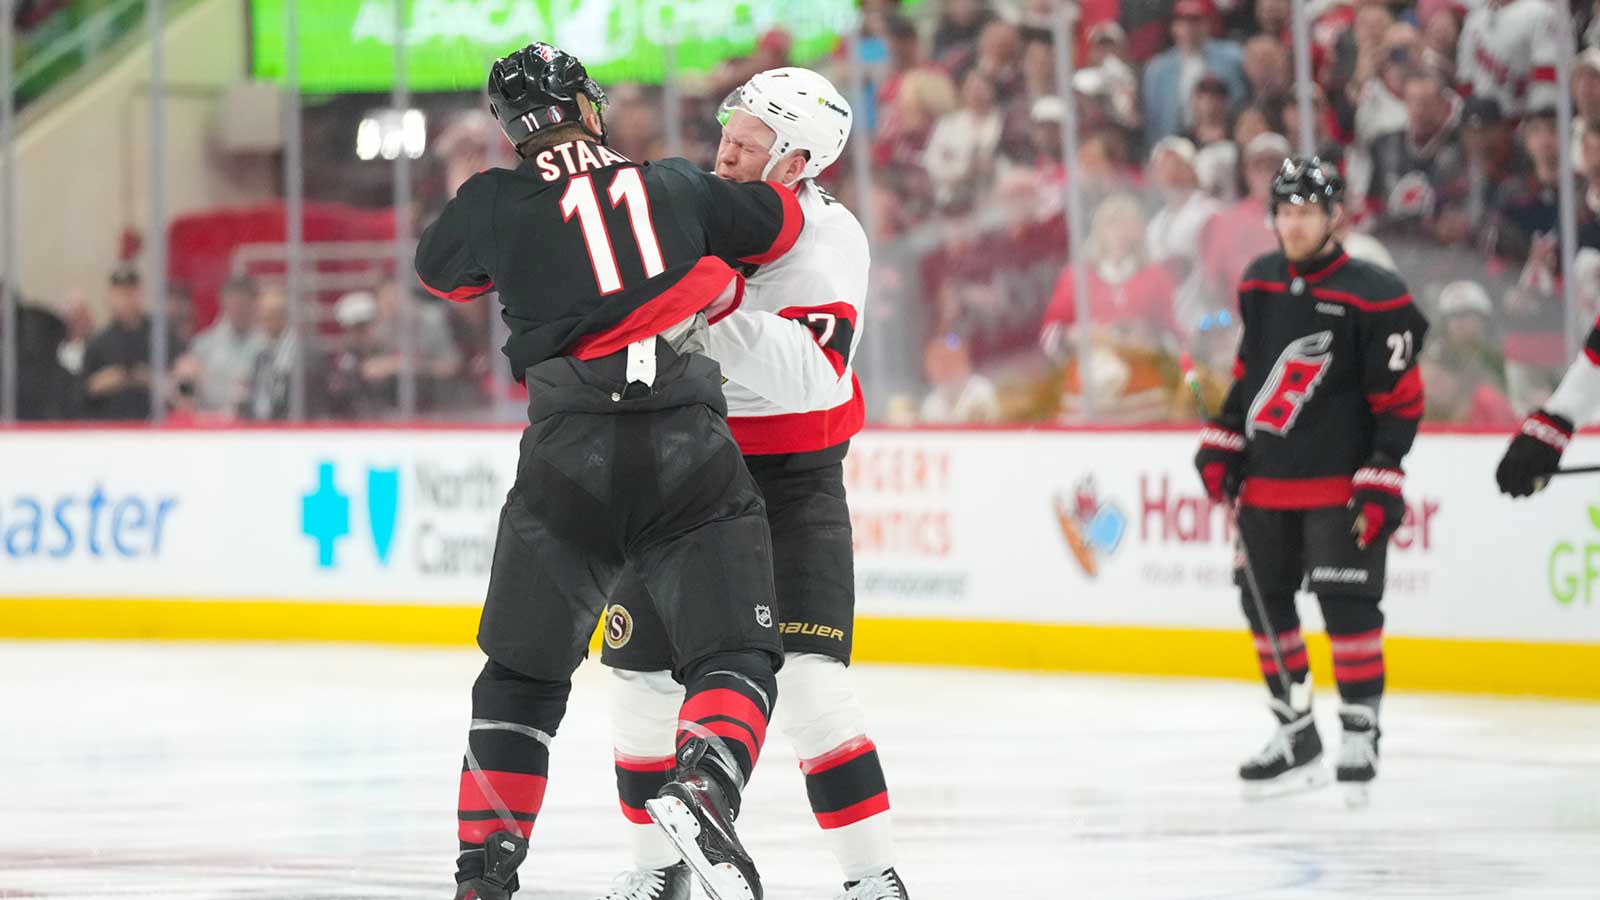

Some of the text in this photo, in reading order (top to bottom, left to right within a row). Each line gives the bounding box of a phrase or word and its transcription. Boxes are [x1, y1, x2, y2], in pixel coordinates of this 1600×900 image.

[521, 112, 541, 133] 11
[559, 166, 667, 297] 11
[807, 312, 836, 347] 7
[1386, 329, 1413, 372] 21
[846, 449, 951, 491] RGERY
[0, 482, 178, 558] aster
[851, 510, 953, 553] ONTICS
[415, 521, 492, 575] Caro
[610, 614, 624, 640] S
